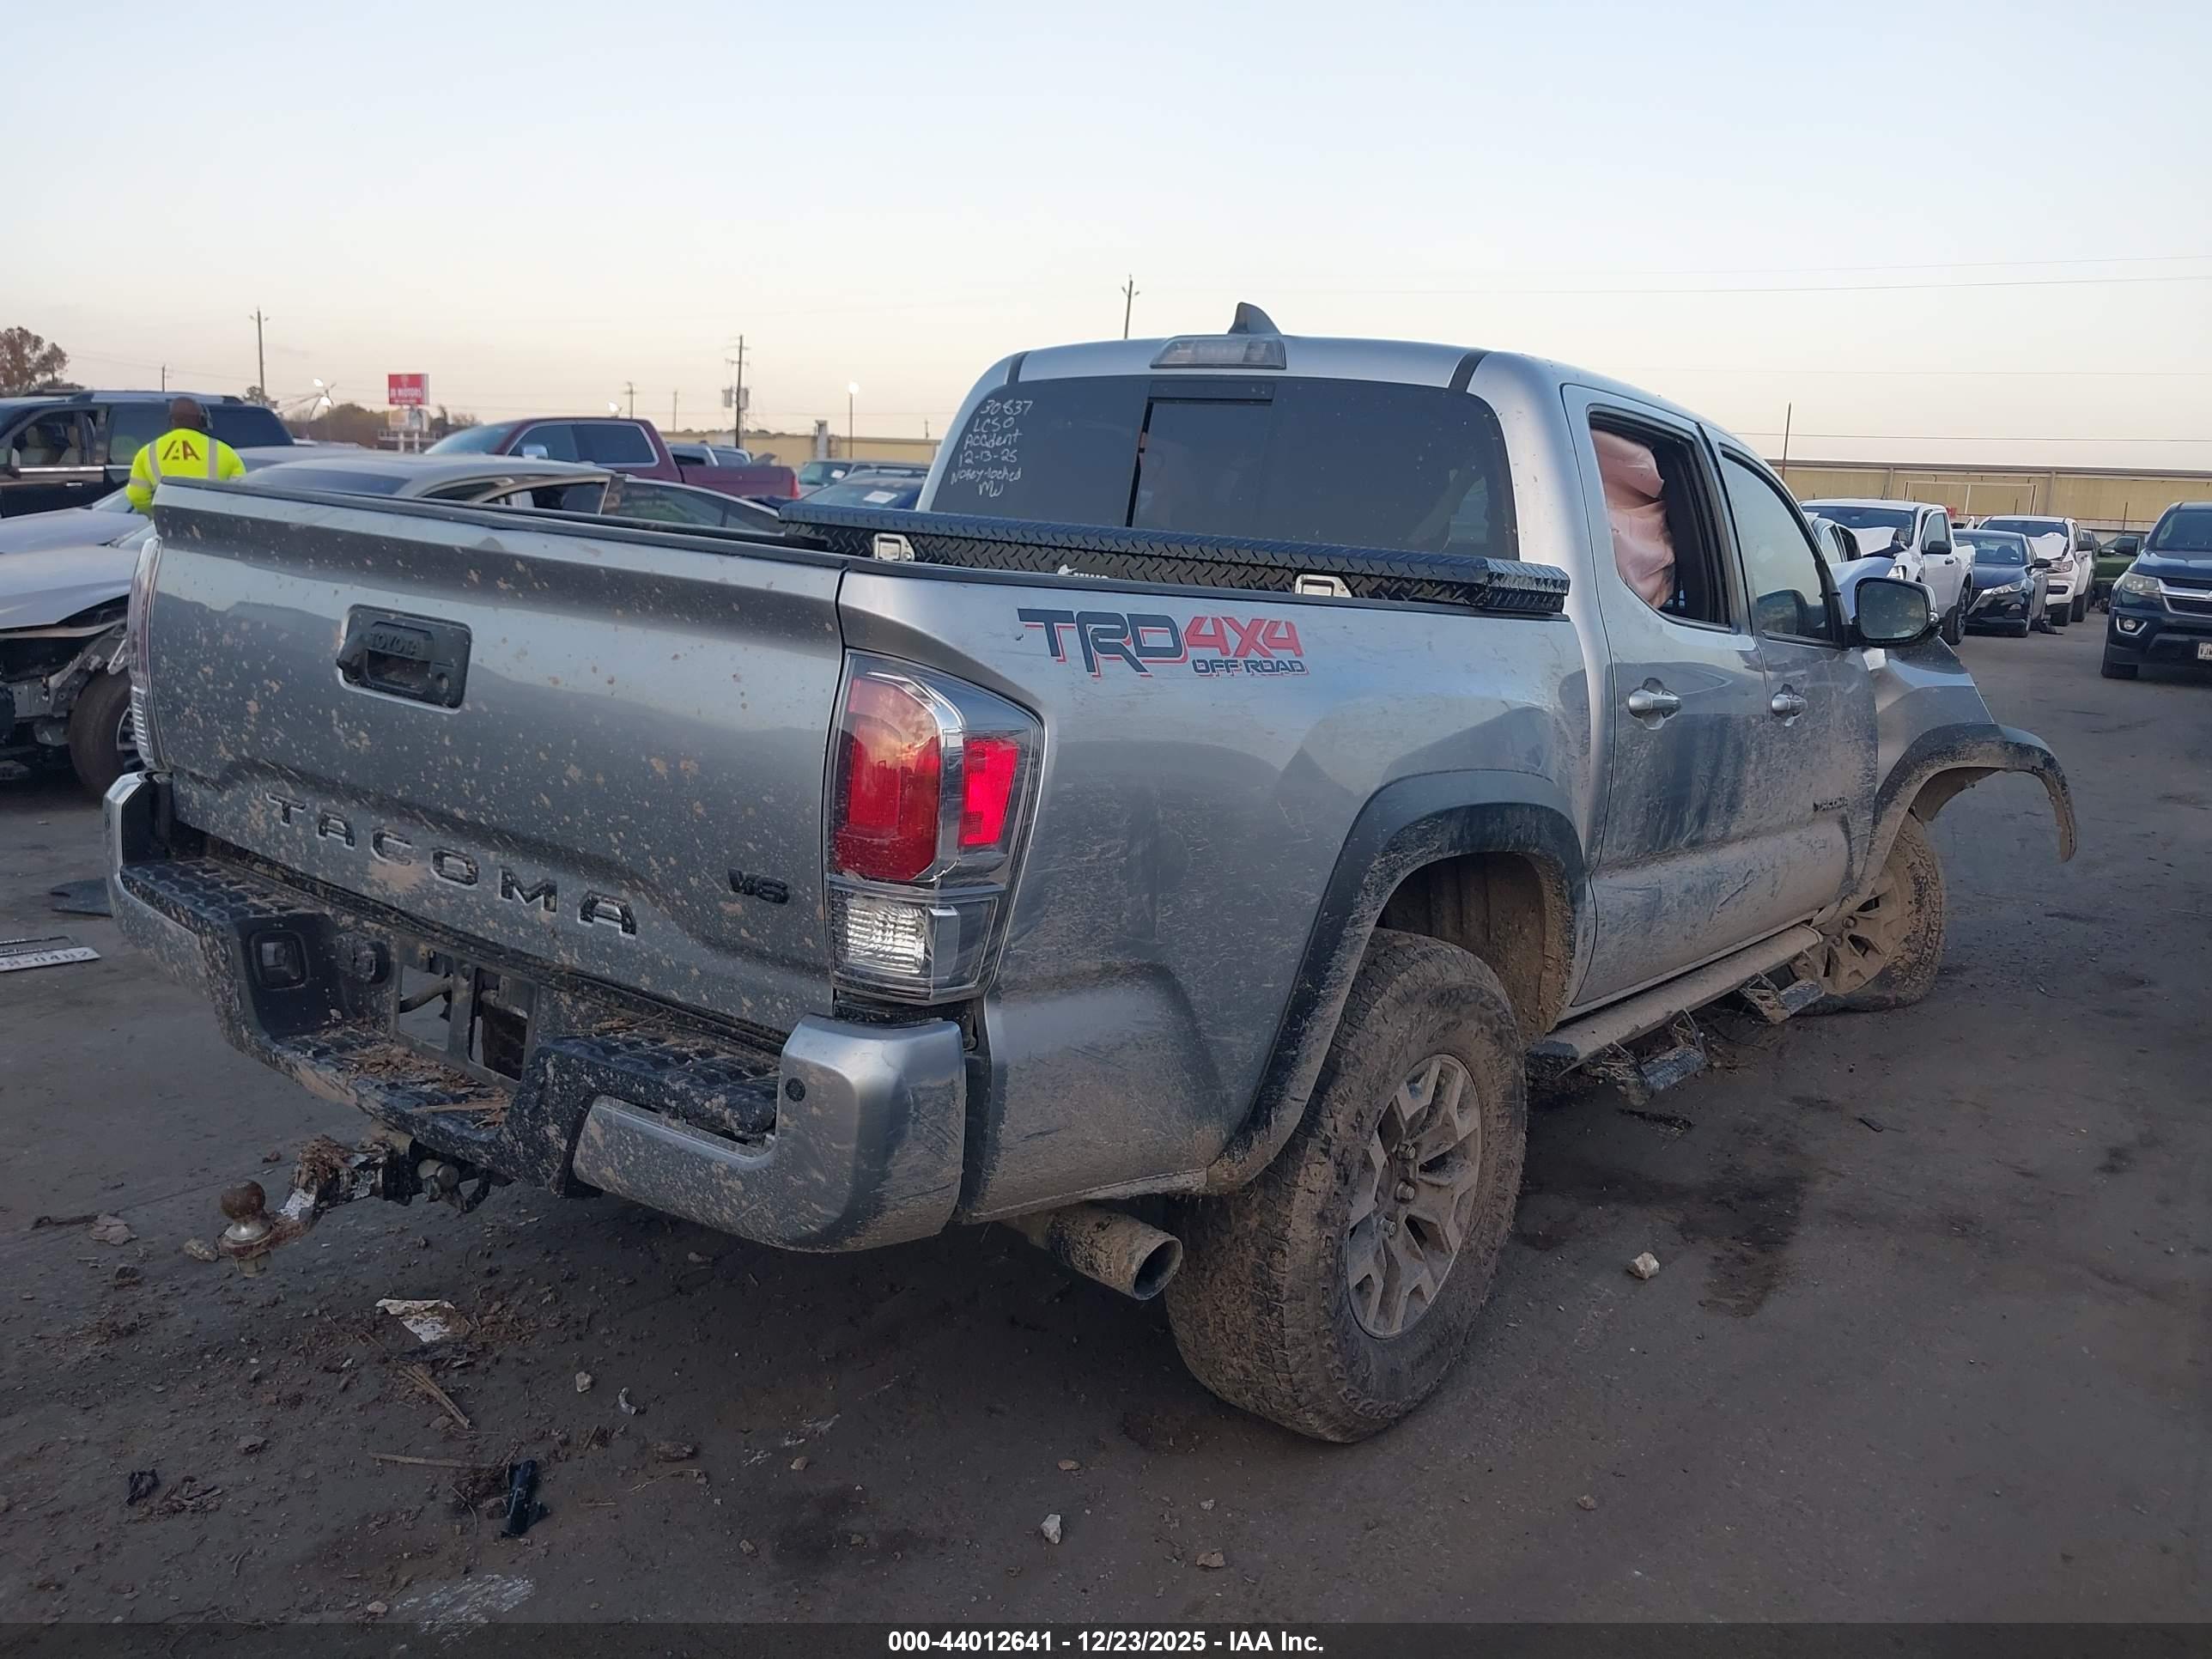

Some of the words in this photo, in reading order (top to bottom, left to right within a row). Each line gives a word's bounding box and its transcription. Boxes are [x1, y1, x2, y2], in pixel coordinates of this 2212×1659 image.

[1017, 608, 1188, 678] TRD
[1192, 659, 1242, 678] OFF
[1243, 659, 1310, 678] ROAD
[265, 791, 636, 940] TACOMA
[726, 866, 789, 905] V6
